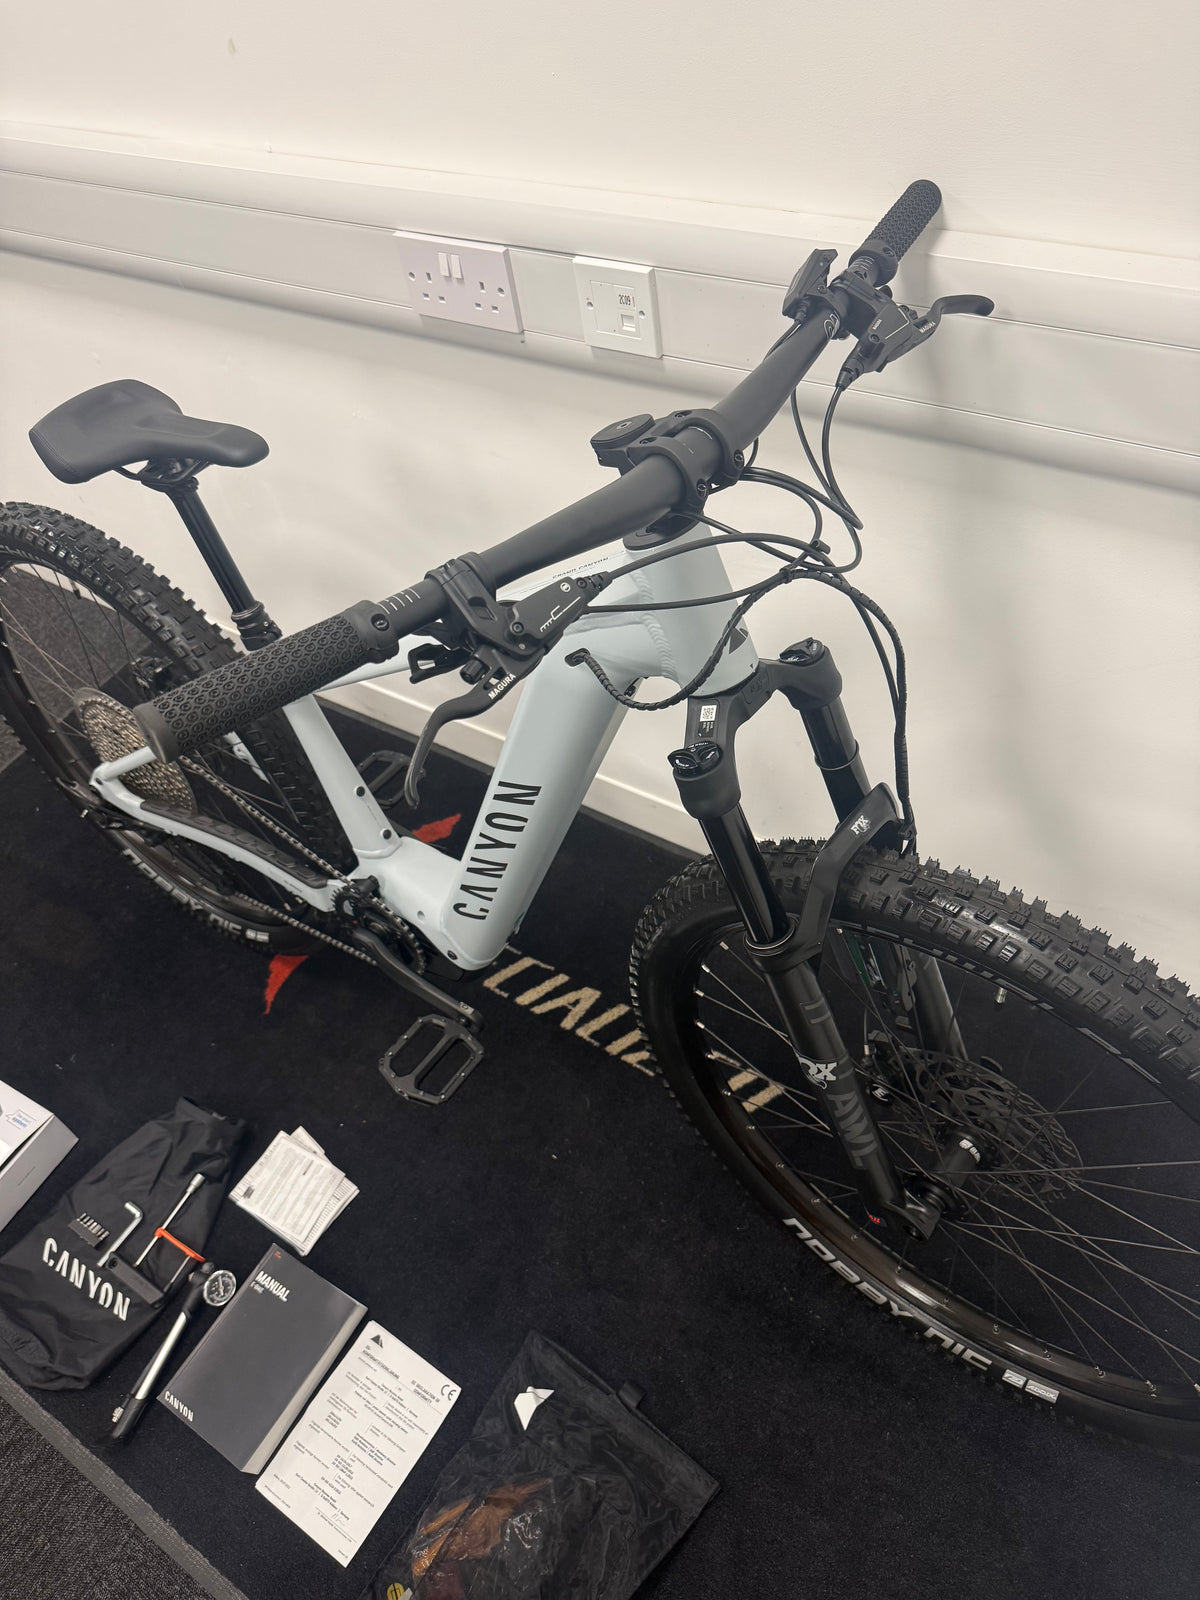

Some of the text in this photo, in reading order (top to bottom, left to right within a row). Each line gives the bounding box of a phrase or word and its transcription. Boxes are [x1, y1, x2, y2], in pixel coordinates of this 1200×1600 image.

[488, 673, 516, 700] MAGURA
[850, 814, 871, 835] FOX
[453, 781, 542, 920] CANYON
[122, 848, 242, 935] NOBBY NIC
[42, 1237, 131, 1321] CANYON
[254, 1270, 291, 1303] MANUAL
[782, 1217, 914, 1318] NOBBY
[924, 1327, 993, 1371] NIC
[164, 1391, 194, 1422] CANYON
[441, 1384, 457, 1402] CE
